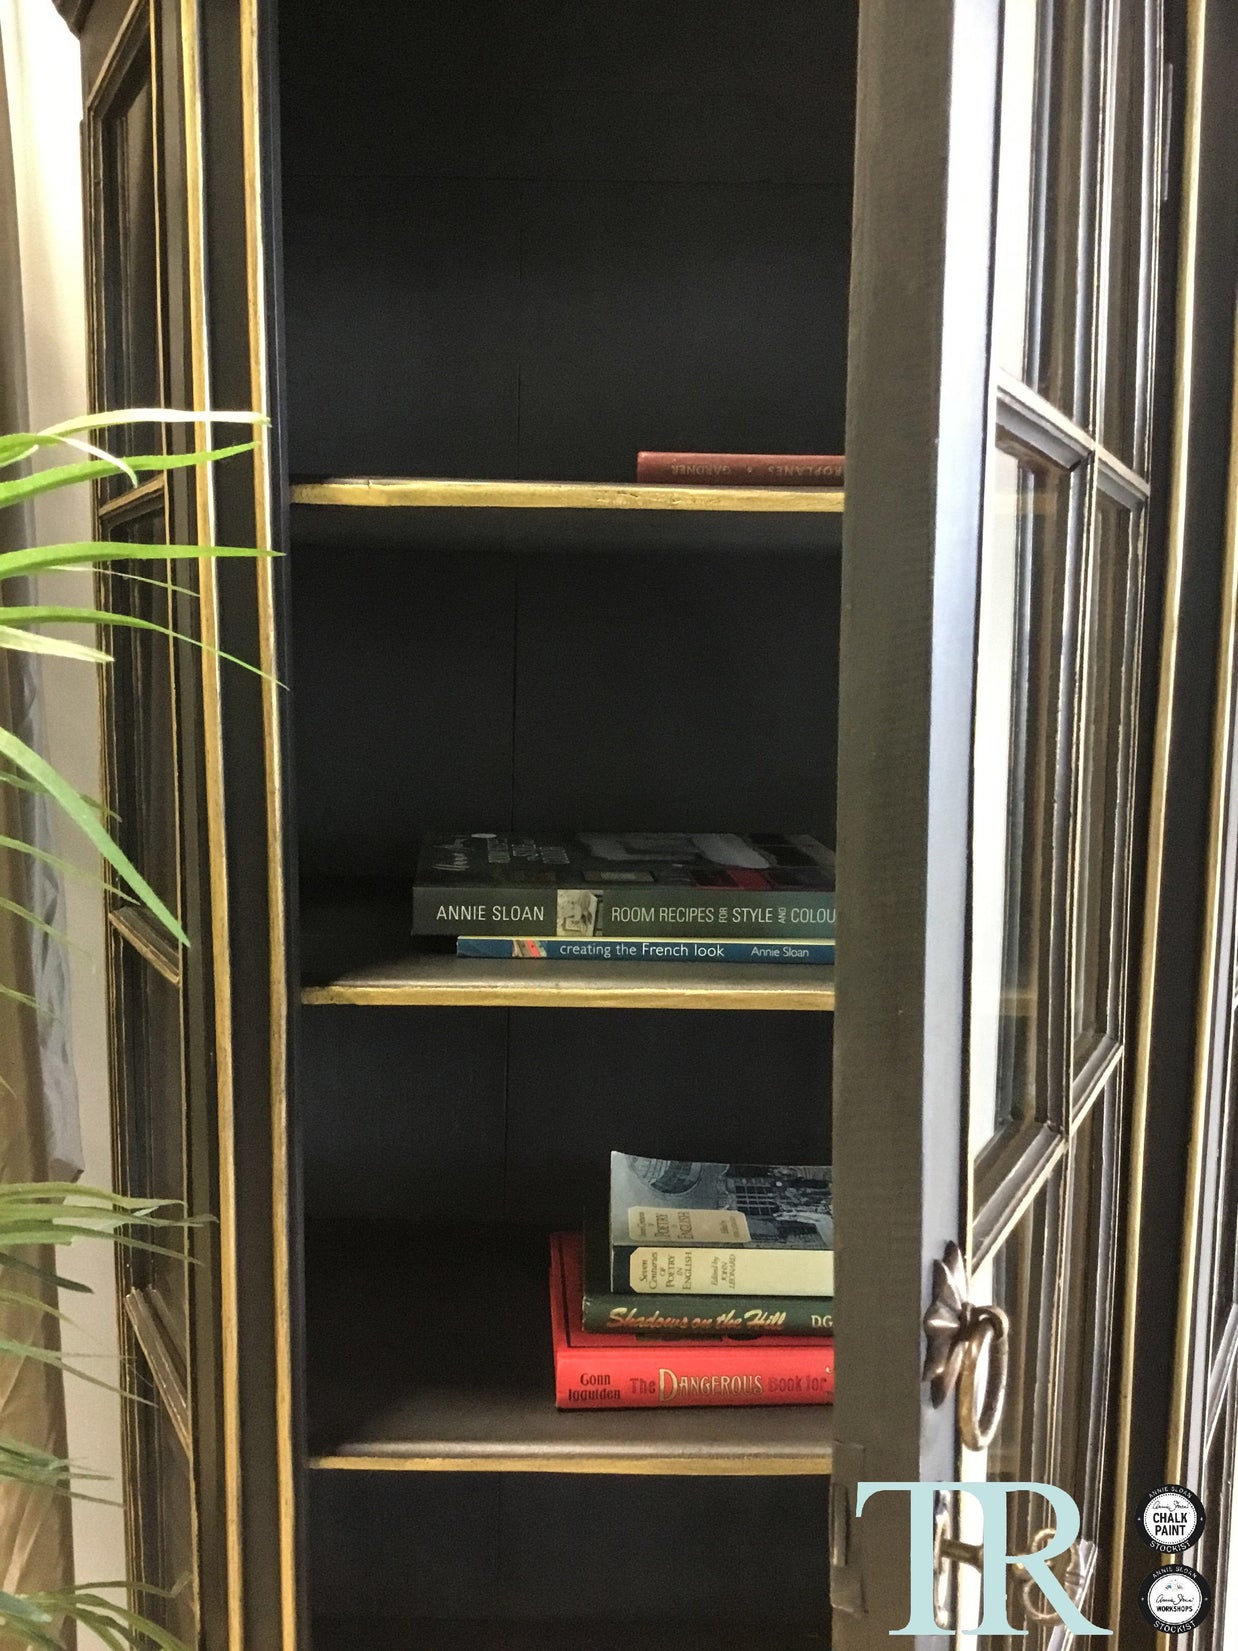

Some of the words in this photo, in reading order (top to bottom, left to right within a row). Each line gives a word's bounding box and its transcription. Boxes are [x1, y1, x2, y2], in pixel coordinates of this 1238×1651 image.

[671, 464, 732, 476] GARDNER
[436, 905, 486, 921] ANNIE
[492, 905, 544, 921] SLOAN
[611, 906, 655, 922] ROOM
[659, 907, 714, 923] RECIPES
[718, 907, 728, 923] FOR
[732, 907, 773, 923] STYLE
[778, 907, 786, 924] AND
[560, 944, 611, 959] creating
[616, 943, 637, 956] the
[642, 943, 689, 957] French
[694, 944, 724, 958] look
[751, 946, 780, 957] Annie
[783, 946, 809, 958] Sloan
[640, 1259, 648, 1282] Seven
[649, 1252, 658, 1290] Centuries
[666, 1255, 675, 1288] POETRY
[683, 1252, 692, 1290] ENGLISH
[606, 1307, 688, 1329] Shadows
[691, 1317, 713, 1328] on
[715, 1309, 742, 1329] the
[744, 1309, 787, 1330] Hill
[629, 1378, 656, 1394] The
[659, 1368, 763, 1401] DANGEROUS
[768, 1376, 802, 1393] Book
[806, 1376, 827, 1392] for
